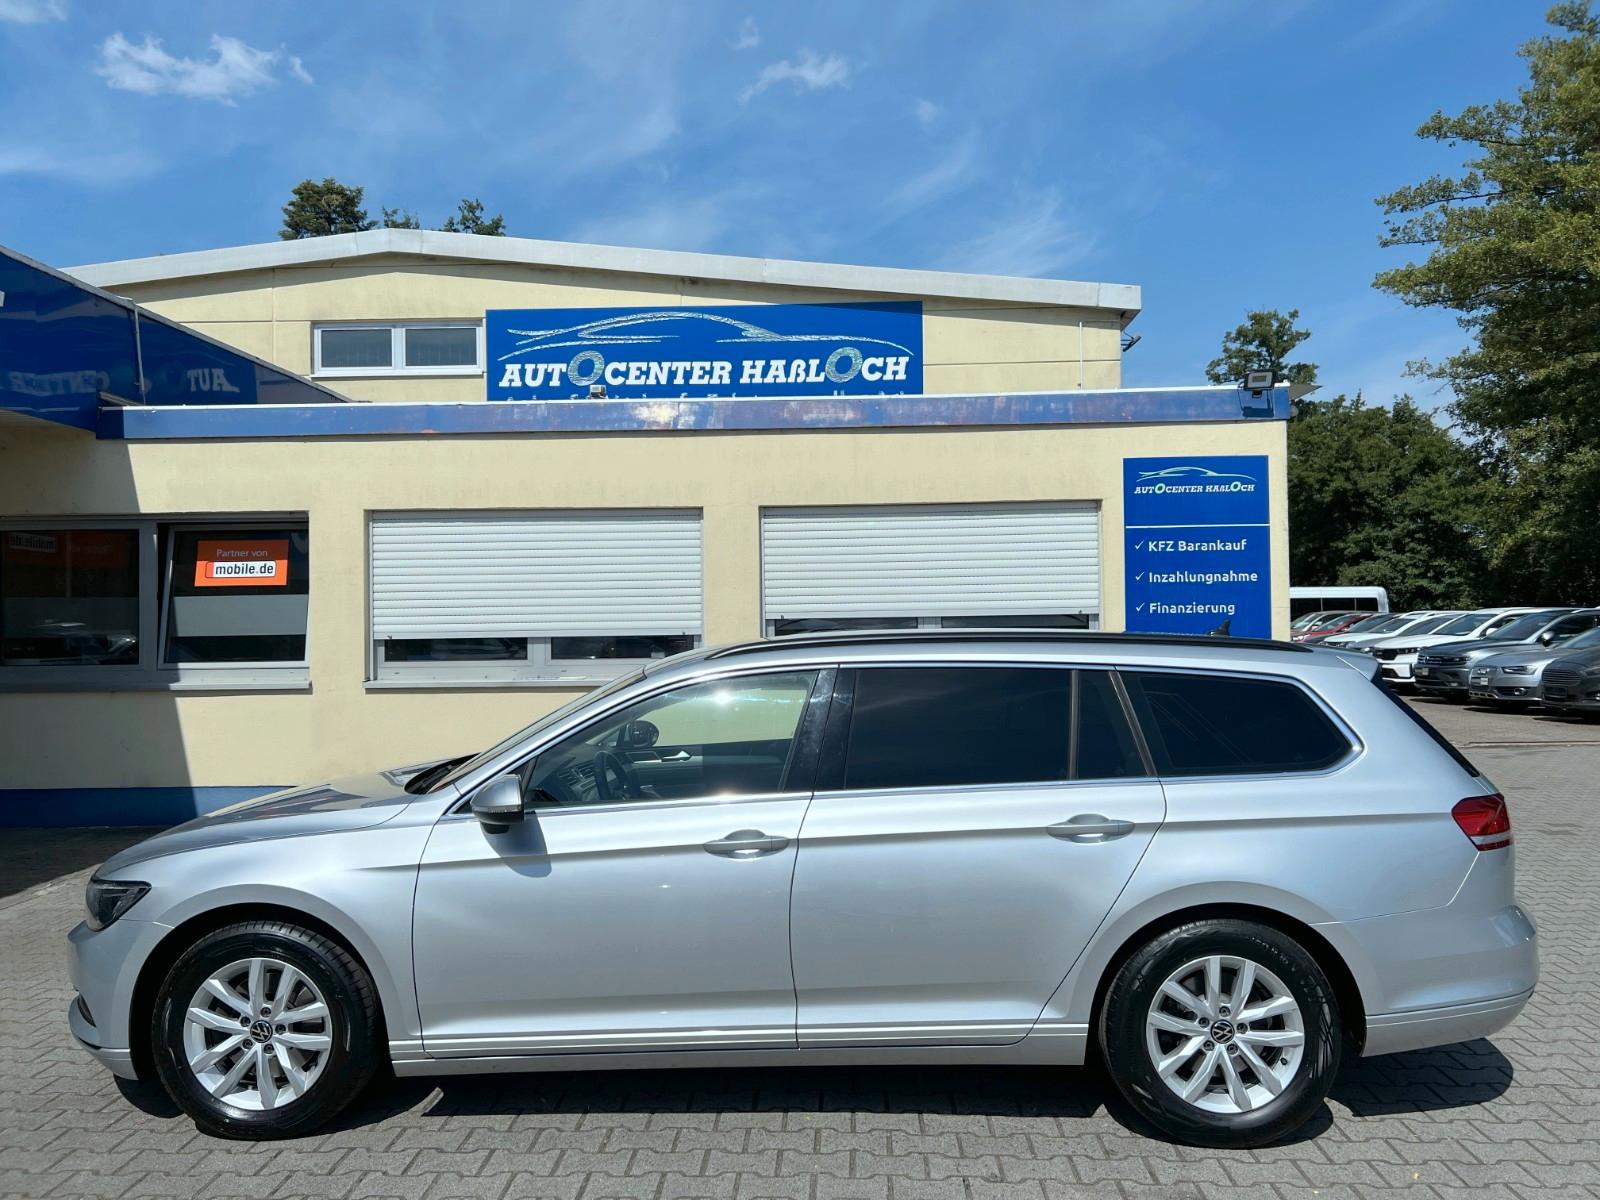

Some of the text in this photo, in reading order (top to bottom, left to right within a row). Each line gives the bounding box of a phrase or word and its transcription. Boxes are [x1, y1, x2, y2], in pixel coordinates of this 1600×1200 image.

[499, 350, 733, 387] AUTOCENTER
[1134, 482, 1203, 494] AUTOCENTER
[1148, 539, 1247, 552] KFZ Barankauf
[216, 549, 268, 558] Partner von
[215, 562, 274, 575] mobile.de
[1149, 571, 1259, 585] Inzahlungnahme
[1149, 602, 1235, 615] Finanzierung
